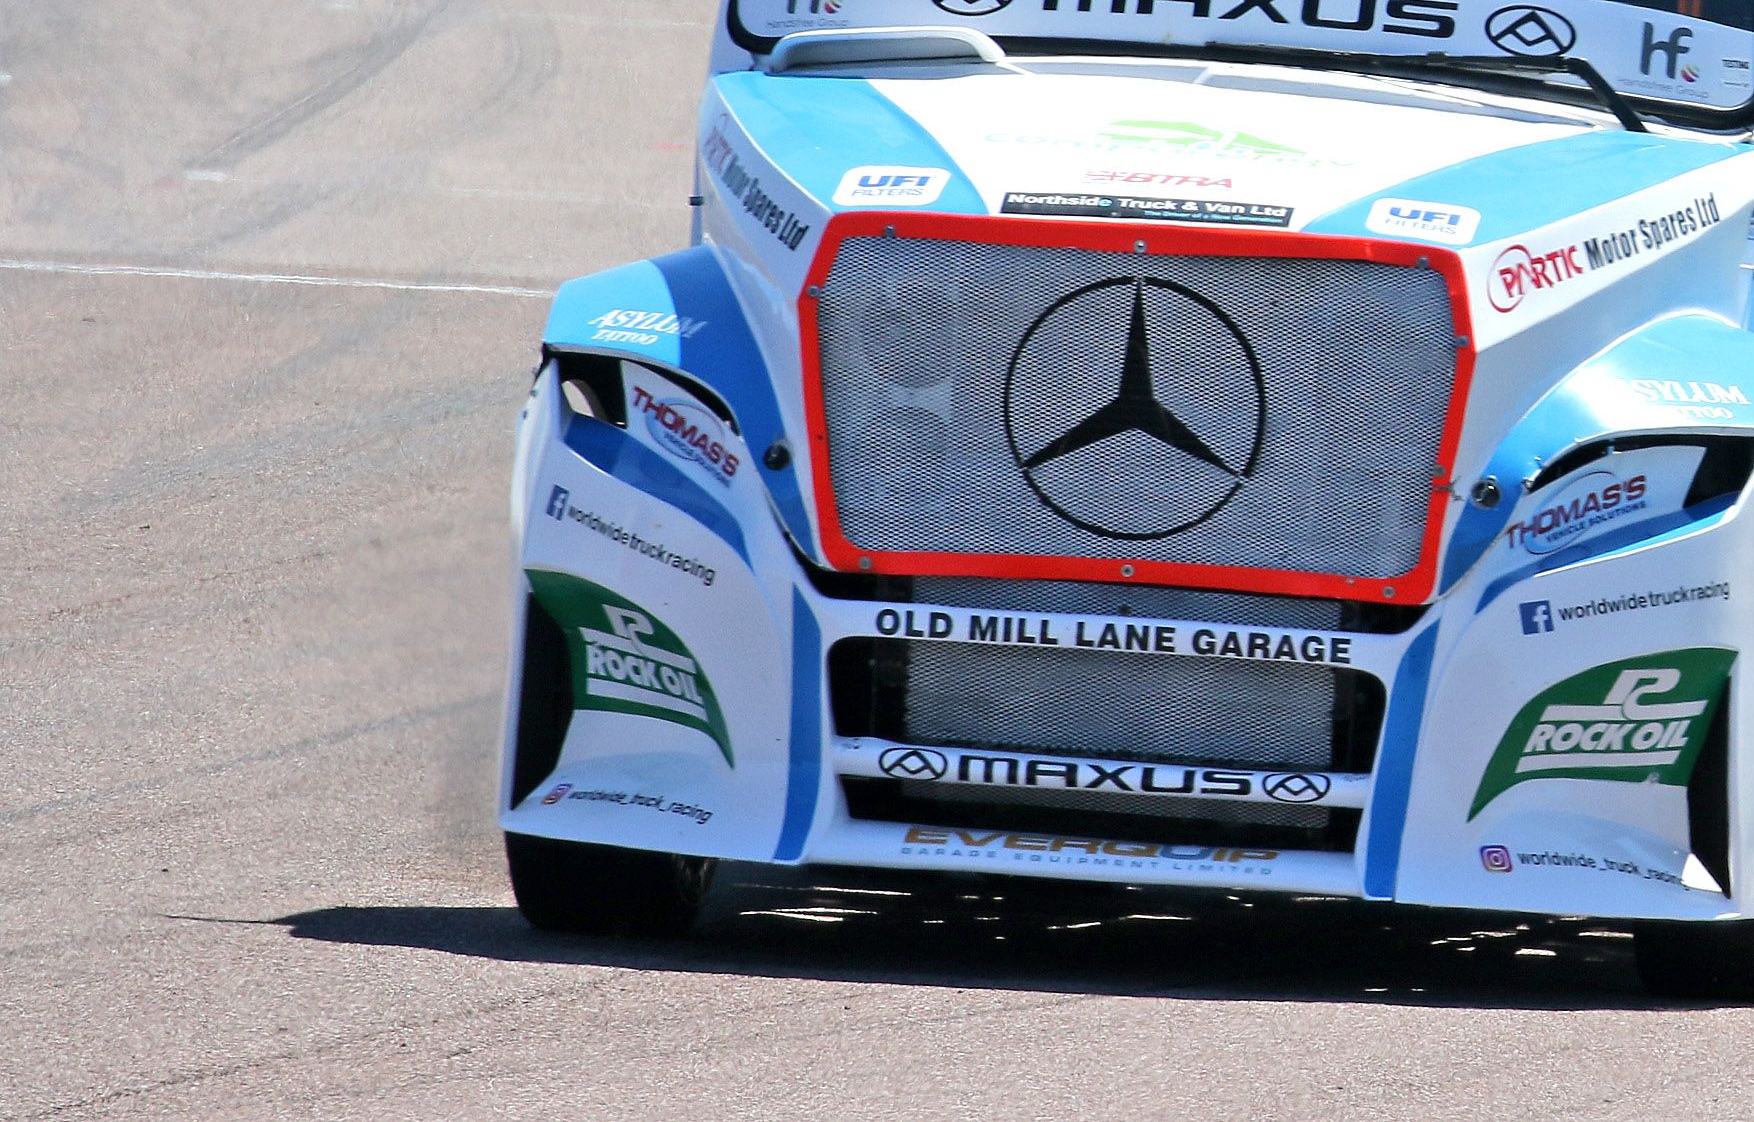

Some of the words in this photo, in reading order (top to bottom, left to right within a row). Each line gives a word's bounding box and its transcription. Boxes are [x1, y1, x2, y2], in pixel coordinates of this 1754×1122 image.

[852, 187, 923, 197] FILTERS
[857, 175, 935, 188] UFI
[742, 178, 782, 236] Spares
[780, 209, 811, 252] Ltd
[1008, 193, 1113, 207] Northside
[1118, 198, 1177, 211] Truck
[1181, 201, 1199, 212] &
[1204, 202, 1246, 216] Van
[1251, 205, 1288, 217] Ltd
[1389, 206, 1461, 226] UFI
[1583, 227, 1641, 270] Motor
[1638, 206, 1698, 250] Spares
[1695, 191, 1721, 230] Ltd
[588, 309, 709, 338] ASYLUM
[592, 329, 659, 345] TATTOO
[1622, 379, 1752, 405] SYLUM
[1505, 475, 1647, 548] THOMAS'S
[1546, 520, 1586, 544] VEHICLE
[1587, 500, 1647, 527] SOLUTIONS
[1558, 580, 1731, 621] worldwidetruckracing
[876, 608, 953, 639] OLD
[969, 614, 1058, 645] MILL
[1076, 621, 1176, 653] LANE
[1192, 629, 1352, 664] GARAGE
[587, 642, 662, 690] ROCK
[660, 667, 703, 705] OIL
[1523, 723, 1634, 753] ROCK
[1631, 720, 1691, 749] OIL
[958, 755, 1254, 796] MAXUS
[900, 846, 997, 859] GARAGE
[1014, 852, 1160, 870] EQUIPMENT
[1173, 861, 1272, 876] LIMITED
[904, 826, 1280, 864] EVERQUIP
